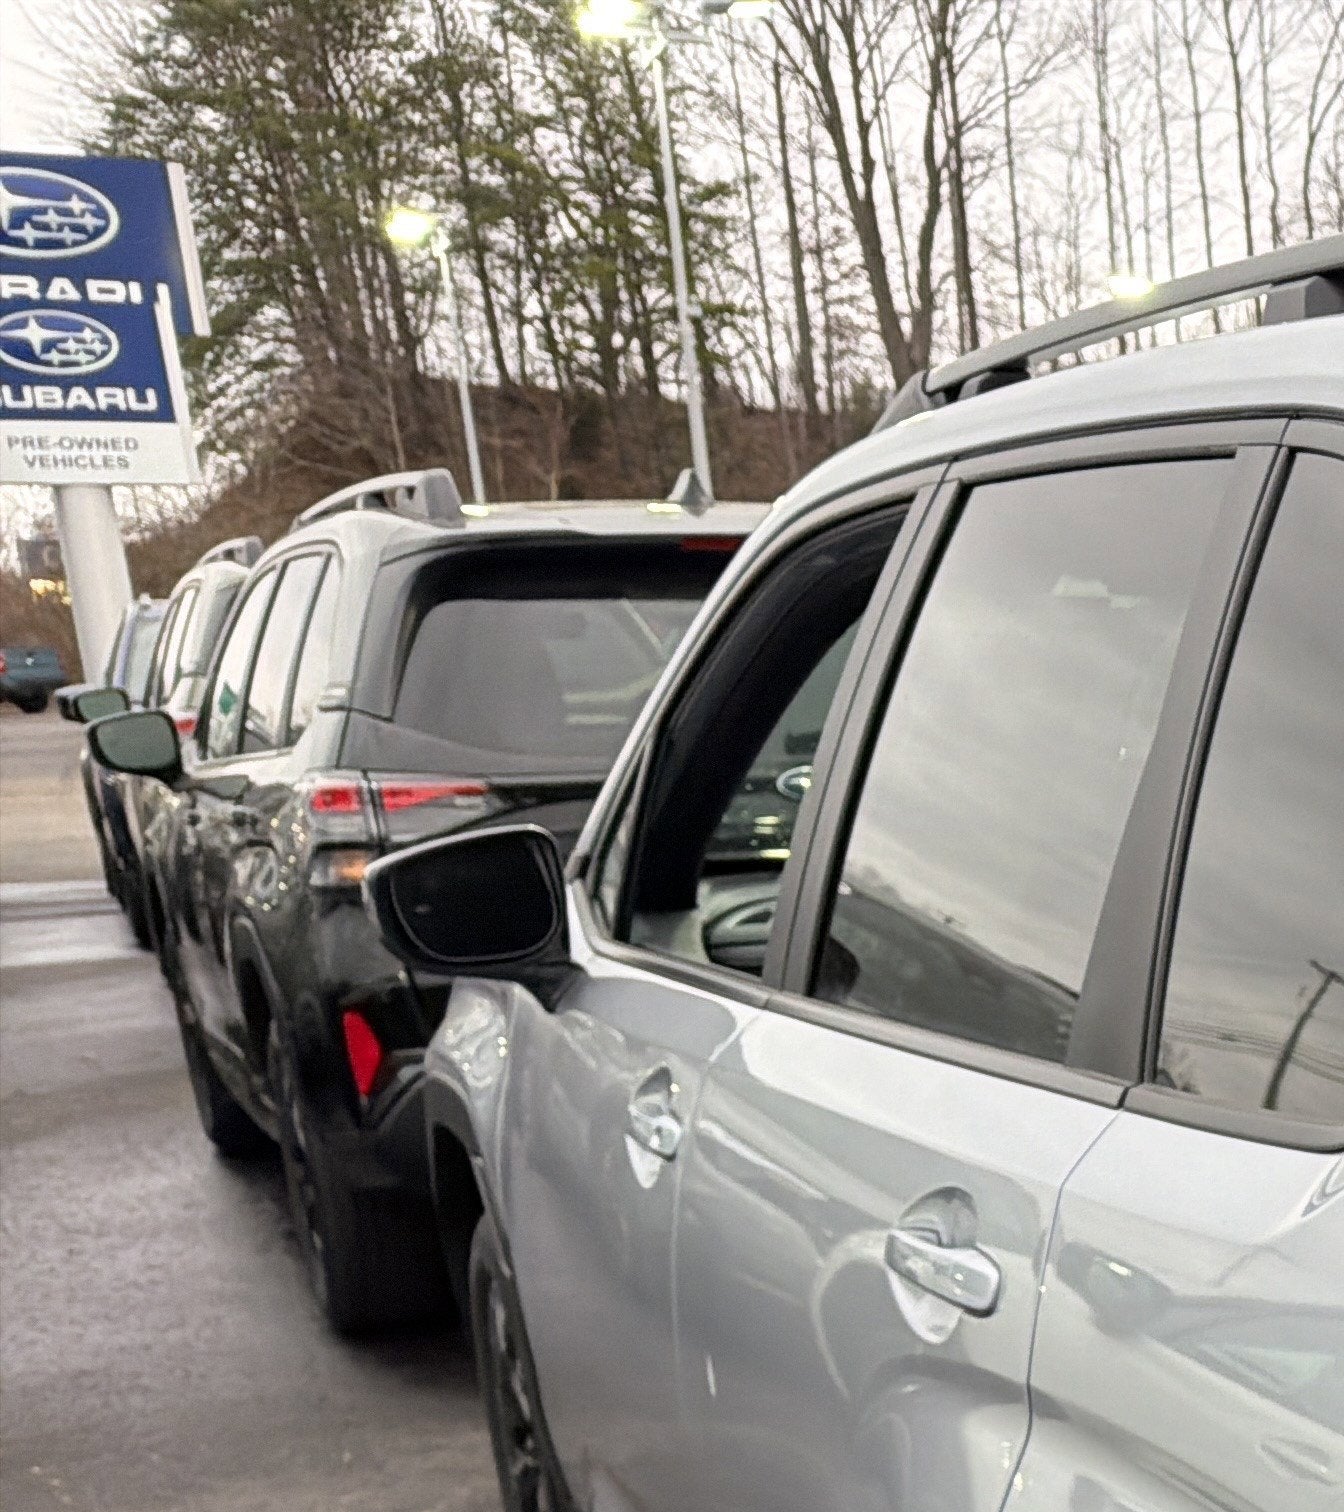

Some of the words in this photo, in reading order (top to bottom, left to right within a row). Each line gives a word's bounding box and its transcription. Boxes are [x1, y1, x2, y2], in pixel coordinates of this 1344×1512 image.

[0, 384, 158, 412] UBARU
[7, 435, 139, 451] PRE-OWNED
[23, 454, 130, 470] VEHICLES
